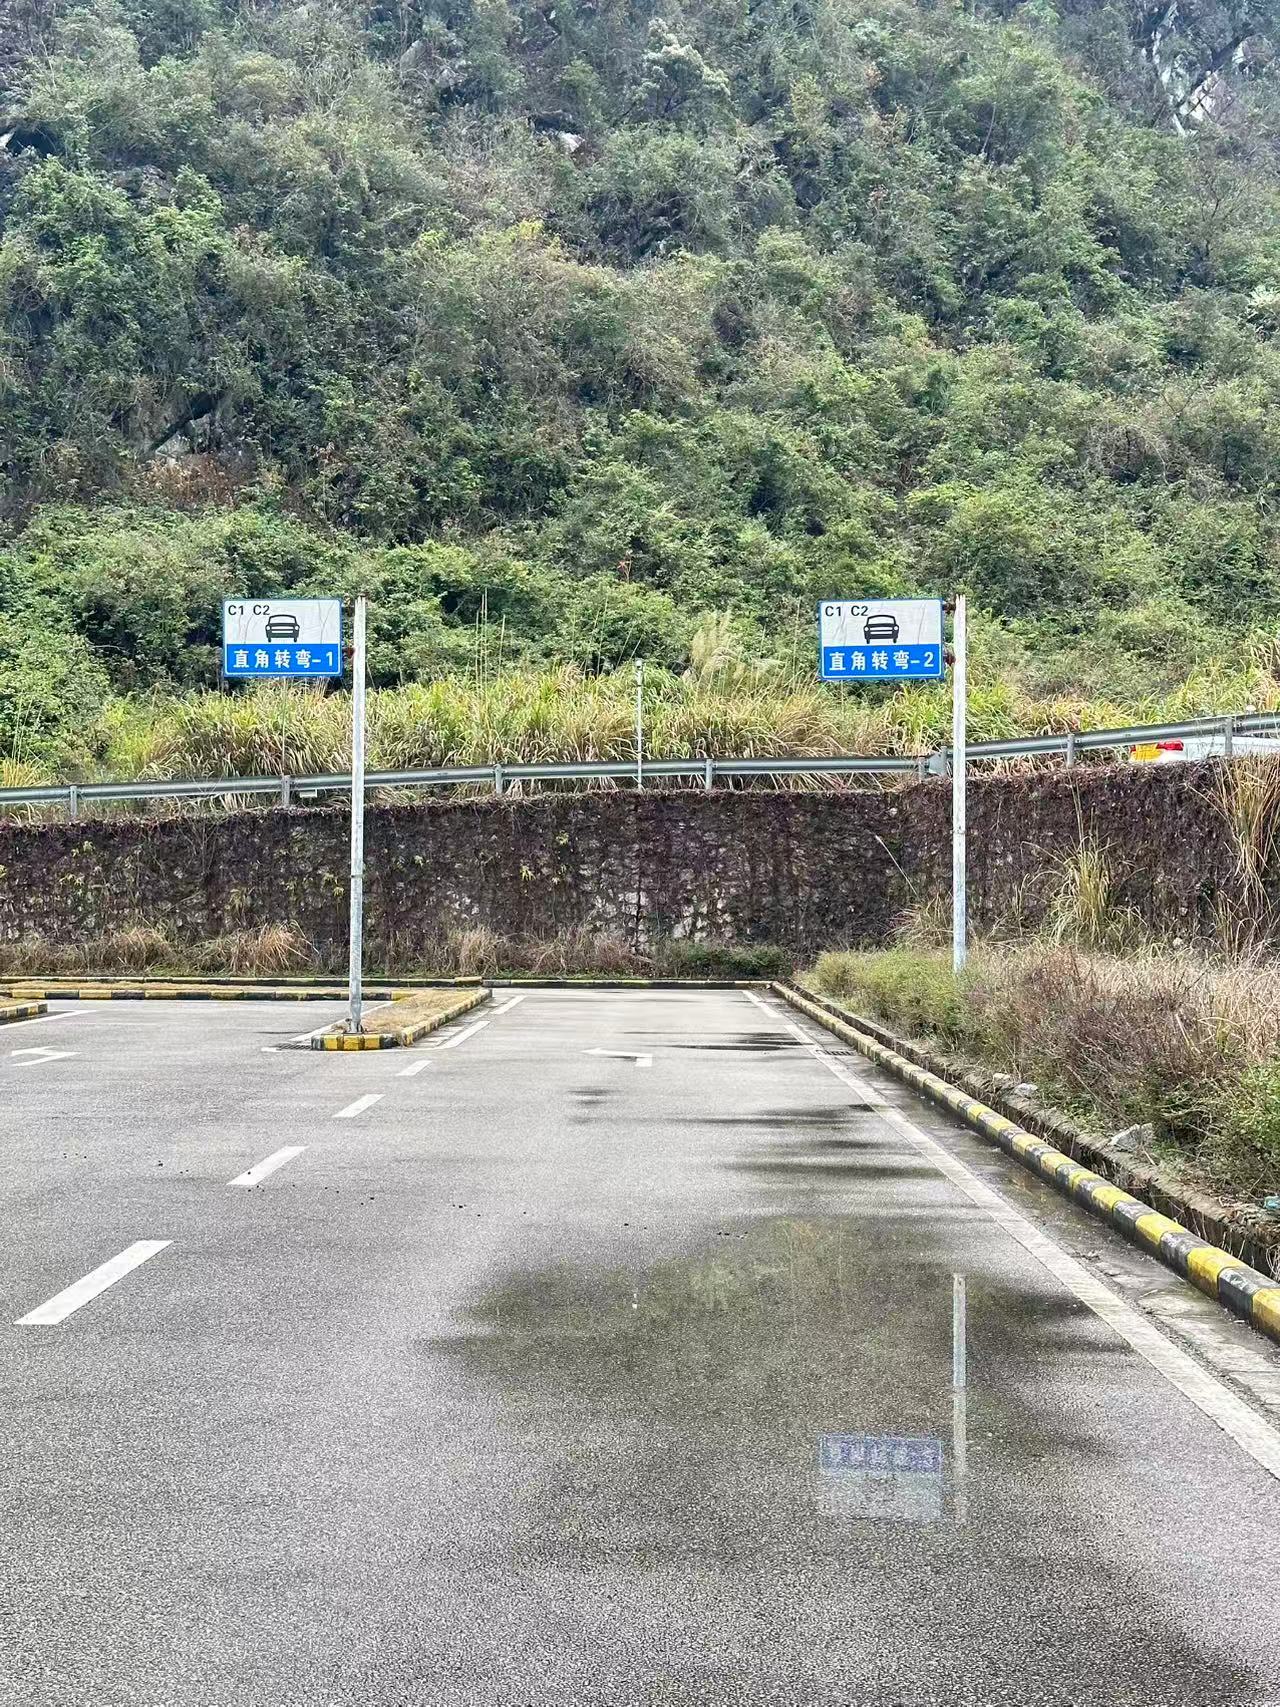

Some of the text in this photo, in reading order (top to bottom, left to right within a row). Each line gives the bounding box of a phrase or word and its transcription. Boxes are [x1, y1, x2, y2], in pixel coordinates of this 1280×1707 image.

[228, 604, 270, 616] C1 C2
[825, 605, 869, 617] C1 C2
[233, 649, 333, 669] 直角转弯-1
[829, 650, 934, 671] 直角转弯-2
